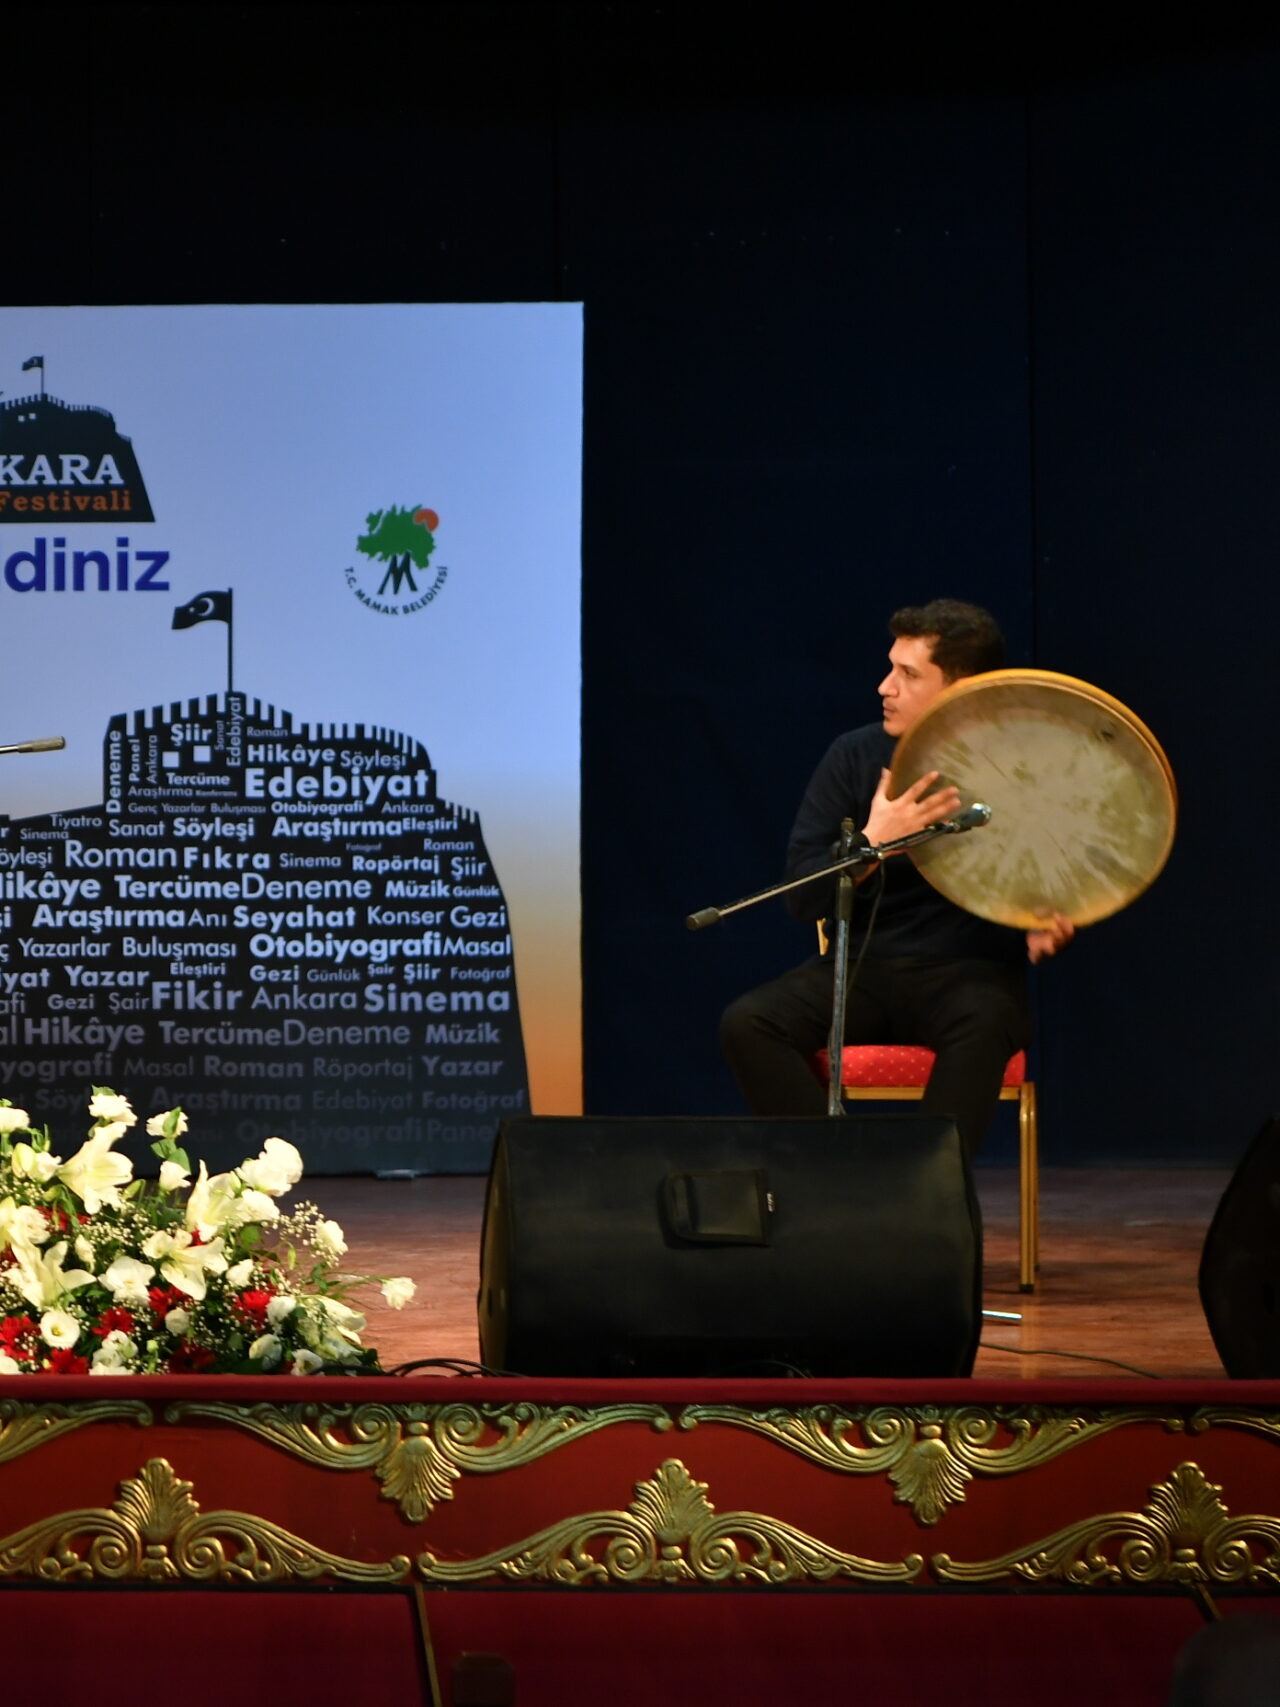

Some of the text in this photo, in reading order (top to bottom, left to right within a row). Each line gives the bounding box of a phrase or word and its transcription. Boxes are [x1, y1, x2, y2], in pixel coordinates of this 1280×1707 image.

[354, 588, 399, 615] MAMAK
[402, 565, 448, 614] BELEDİYESİ
[171, 724, 212, 746] Şiir
[214, 720, 224, 750] Sanat
[226, 696, 243, 767] Edebiyat
[247, 726, 288, 738] Roman
[128, 739, 140, 782] Panel
[146, 735, 157, 784] Ankara
[248, 744, 407, 771] Hikâye Söyleşi
[106, 731, 122, 813] Deneme
[128, 786, 193, 798] Araştırma
[166, 767, 429, 806] Tercüme Edebiyat
[128, 803, 157, 814] Genç
[162, 803, 206, 813] Yazarlar
[271, 800, 363, 815] Otobiyografi
[382, 801, 434, 813] Ankara
[20, 827, 69, 840] Sinema
[50, 814, 458, 841] Tiyatro Sanat Söyleşi Araştırma Eleştiri
[424, 838, 474, 851] Roman
[66, 840, 176, 867] Roman
[184, 846, 269, 869] Fıkra
[280, 853, 341, 867] Sinema
[353, 855, 439, 874] Ropörtaj
[451, 857, 486, 880] Şiir
[114, 875, 240, 898] Tercüme
[242, 873, 371, 899] Deneme
[386, 880, 450, 897] Müzik
[453, 886, 499, 897] Günlük
[32, 904, 185, 933] Araştırma
[188, 909, 226, 926] Anı
[234, 905, 355, 933] Seyahat
[368, 906, 444, 925] Konser
[450, 906, 505, 927] Gezi
[18, 936, 111, 957] Yazarlar
[123, 936, 236, 961] Buluşması
[250, 931, 441, 962] Otobiyografi
[442, 935, 512, 957] Masal
[64, 965, 149, 986] Yazar
[170, 962, 225, 977] Eleştiri
[249, 964, 300, 984] Gezi
[307, 968, 360, 982] Günlük
[368, 964, 394, 977] Şair
[404, 964, 440, 984] Şiir
[451, 966, 510, 982] Fotoğraf
[48, 994, 94, 1009] Gezi
[109, 992, 149, 1014] Şair
[152, 980, 242, 1010] Fikir
[251, 985, 356, 1009] Ankara
[364, 983, 509, 1012] Sinema
[24, 1016, 144, 1051] Hikâye
[159, 1021, 282, 1046] Tercüme
[284, 1019, 410, 1045] Deneme
[426, 1022, 499, 1044] Müzik
[124, 1056, 194, 1076] Masal
[205, 1055, 304, 1078] Roman
[313, 1057, 412, 1081] Röportaj
[422, 1056, 503, 1076] Yazar
[150, 1086, 301, 1114] Araştırma
[312, 1088, 413, 1113] Edebiyat
[422, 1089, 524, 1113] Fotoğraf
